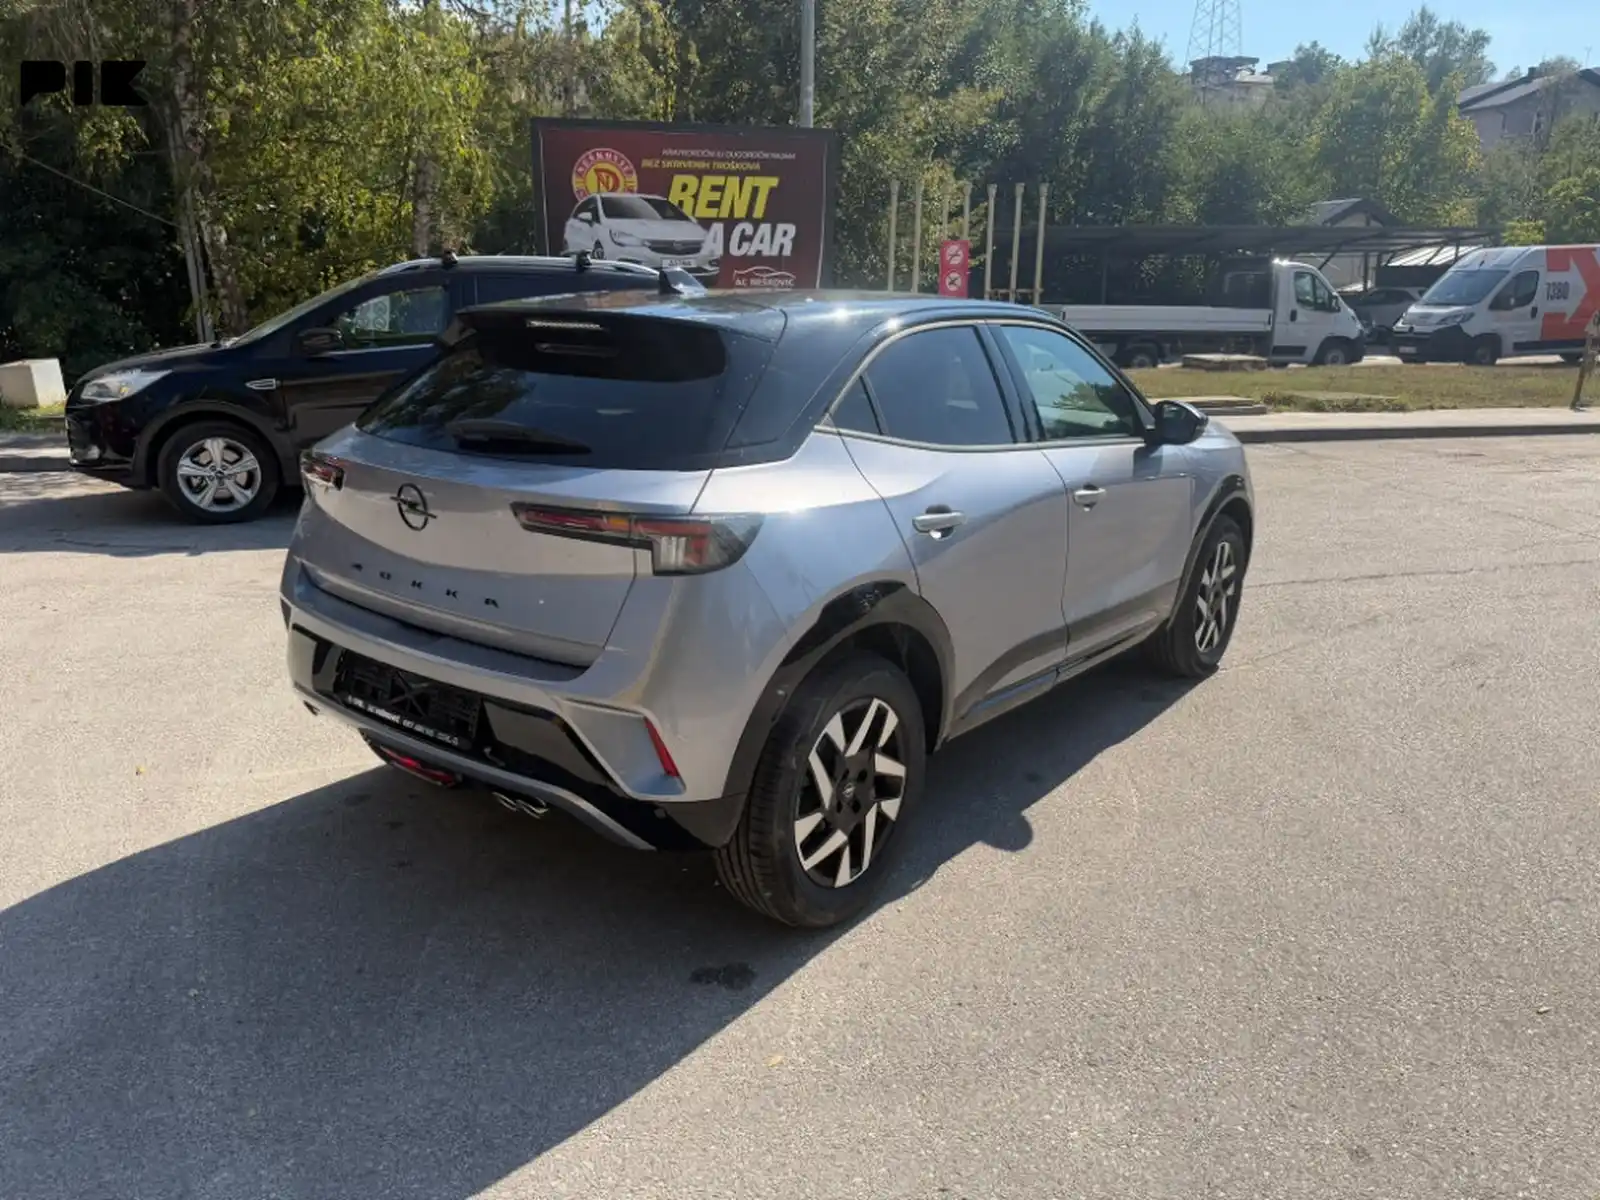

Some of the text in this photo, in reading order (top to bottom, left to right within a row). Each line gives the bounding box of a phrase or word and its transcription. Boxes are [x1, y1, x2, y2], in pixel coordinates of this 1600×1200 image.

[668, 175, 780, 219] RENT
[703, 222, 796, 257] A CAR
